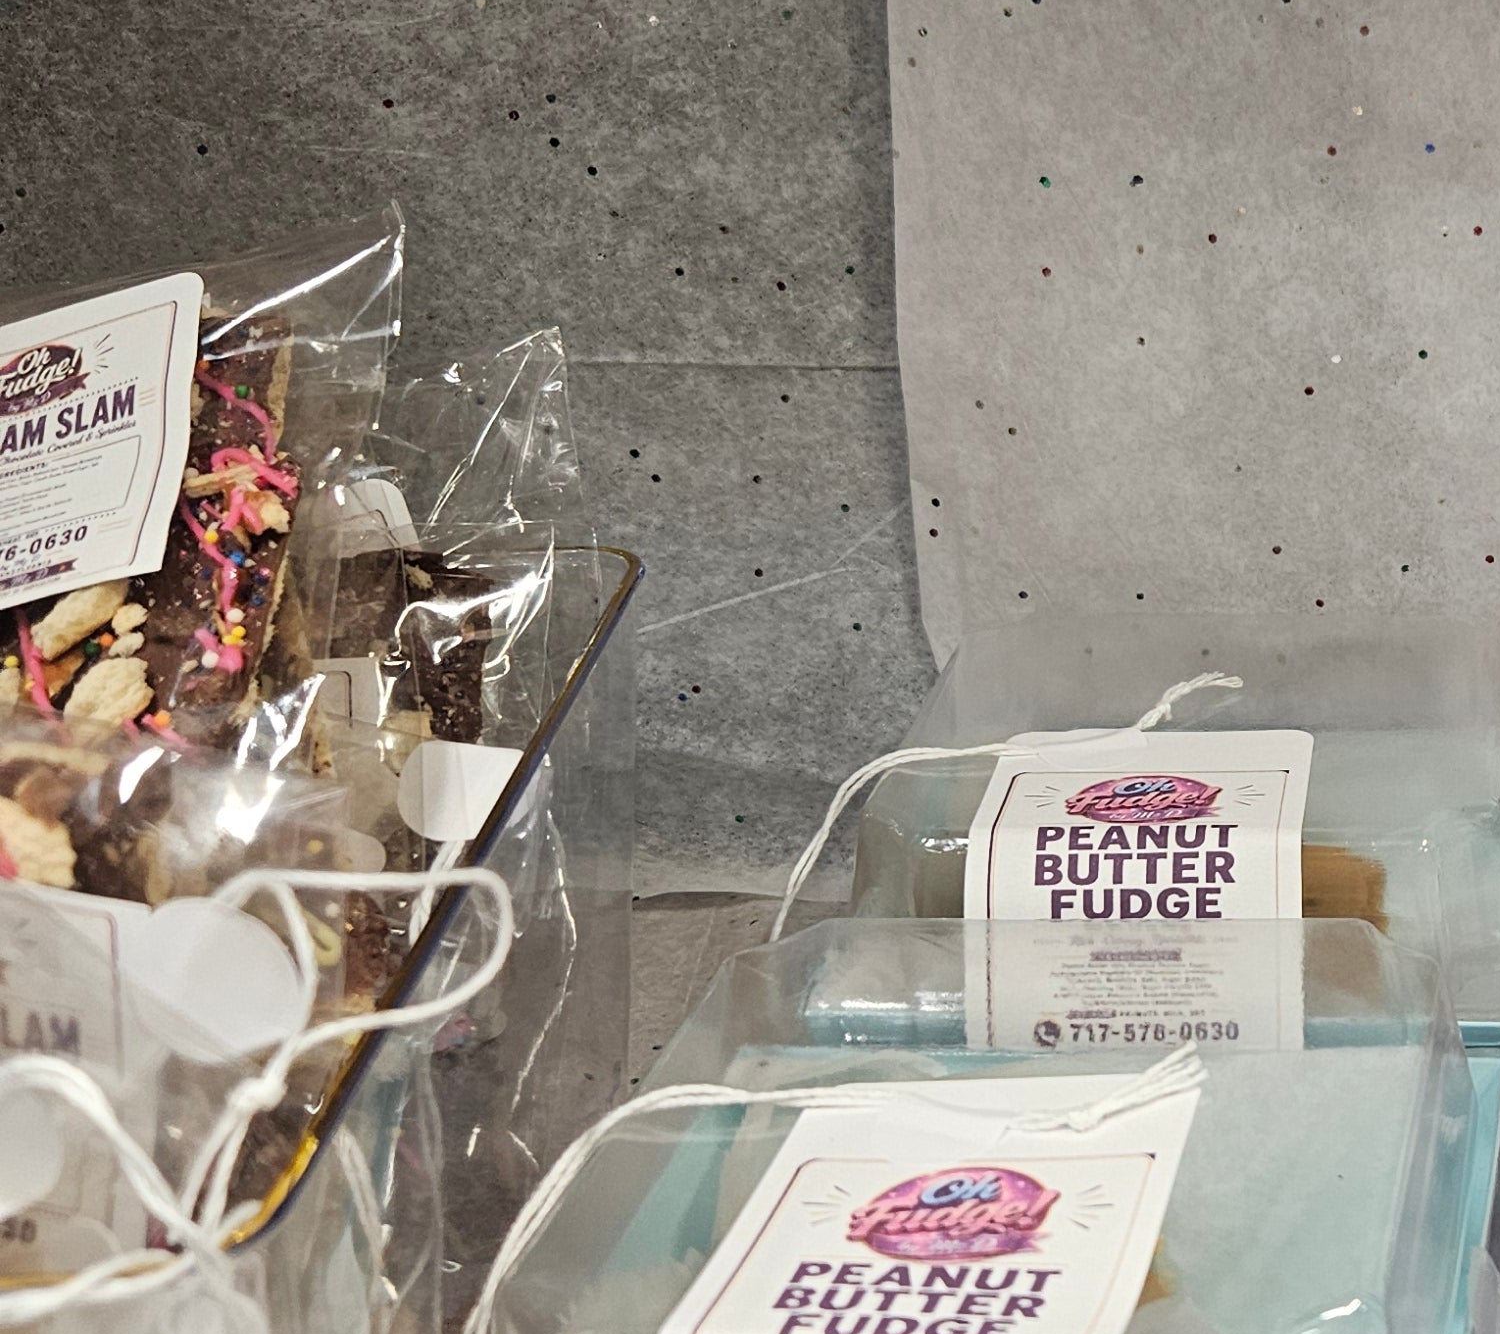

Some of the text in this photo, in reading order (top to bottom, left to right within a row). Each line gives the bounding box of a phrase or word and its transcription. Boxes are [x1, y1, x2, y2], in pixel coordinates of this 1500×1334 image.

[17, 347, 52, 374] Oh
[55, 383, 136, 439] SLAM
[1065, 786, 1223, 815] Fudge!
[1113, 778, 1177, 797] Oh
[1036, 824, 1239, 851] PEANUT
[1034, 851, 1236, 886] BUTTER
[1051, 887, 1222, 919] FUDGE
[919, 1172, 1003, 1206] Oh
[790, 1261, 1063, 1292] PEANUT
[773, 1286, 1046, 1318] BUTTER
